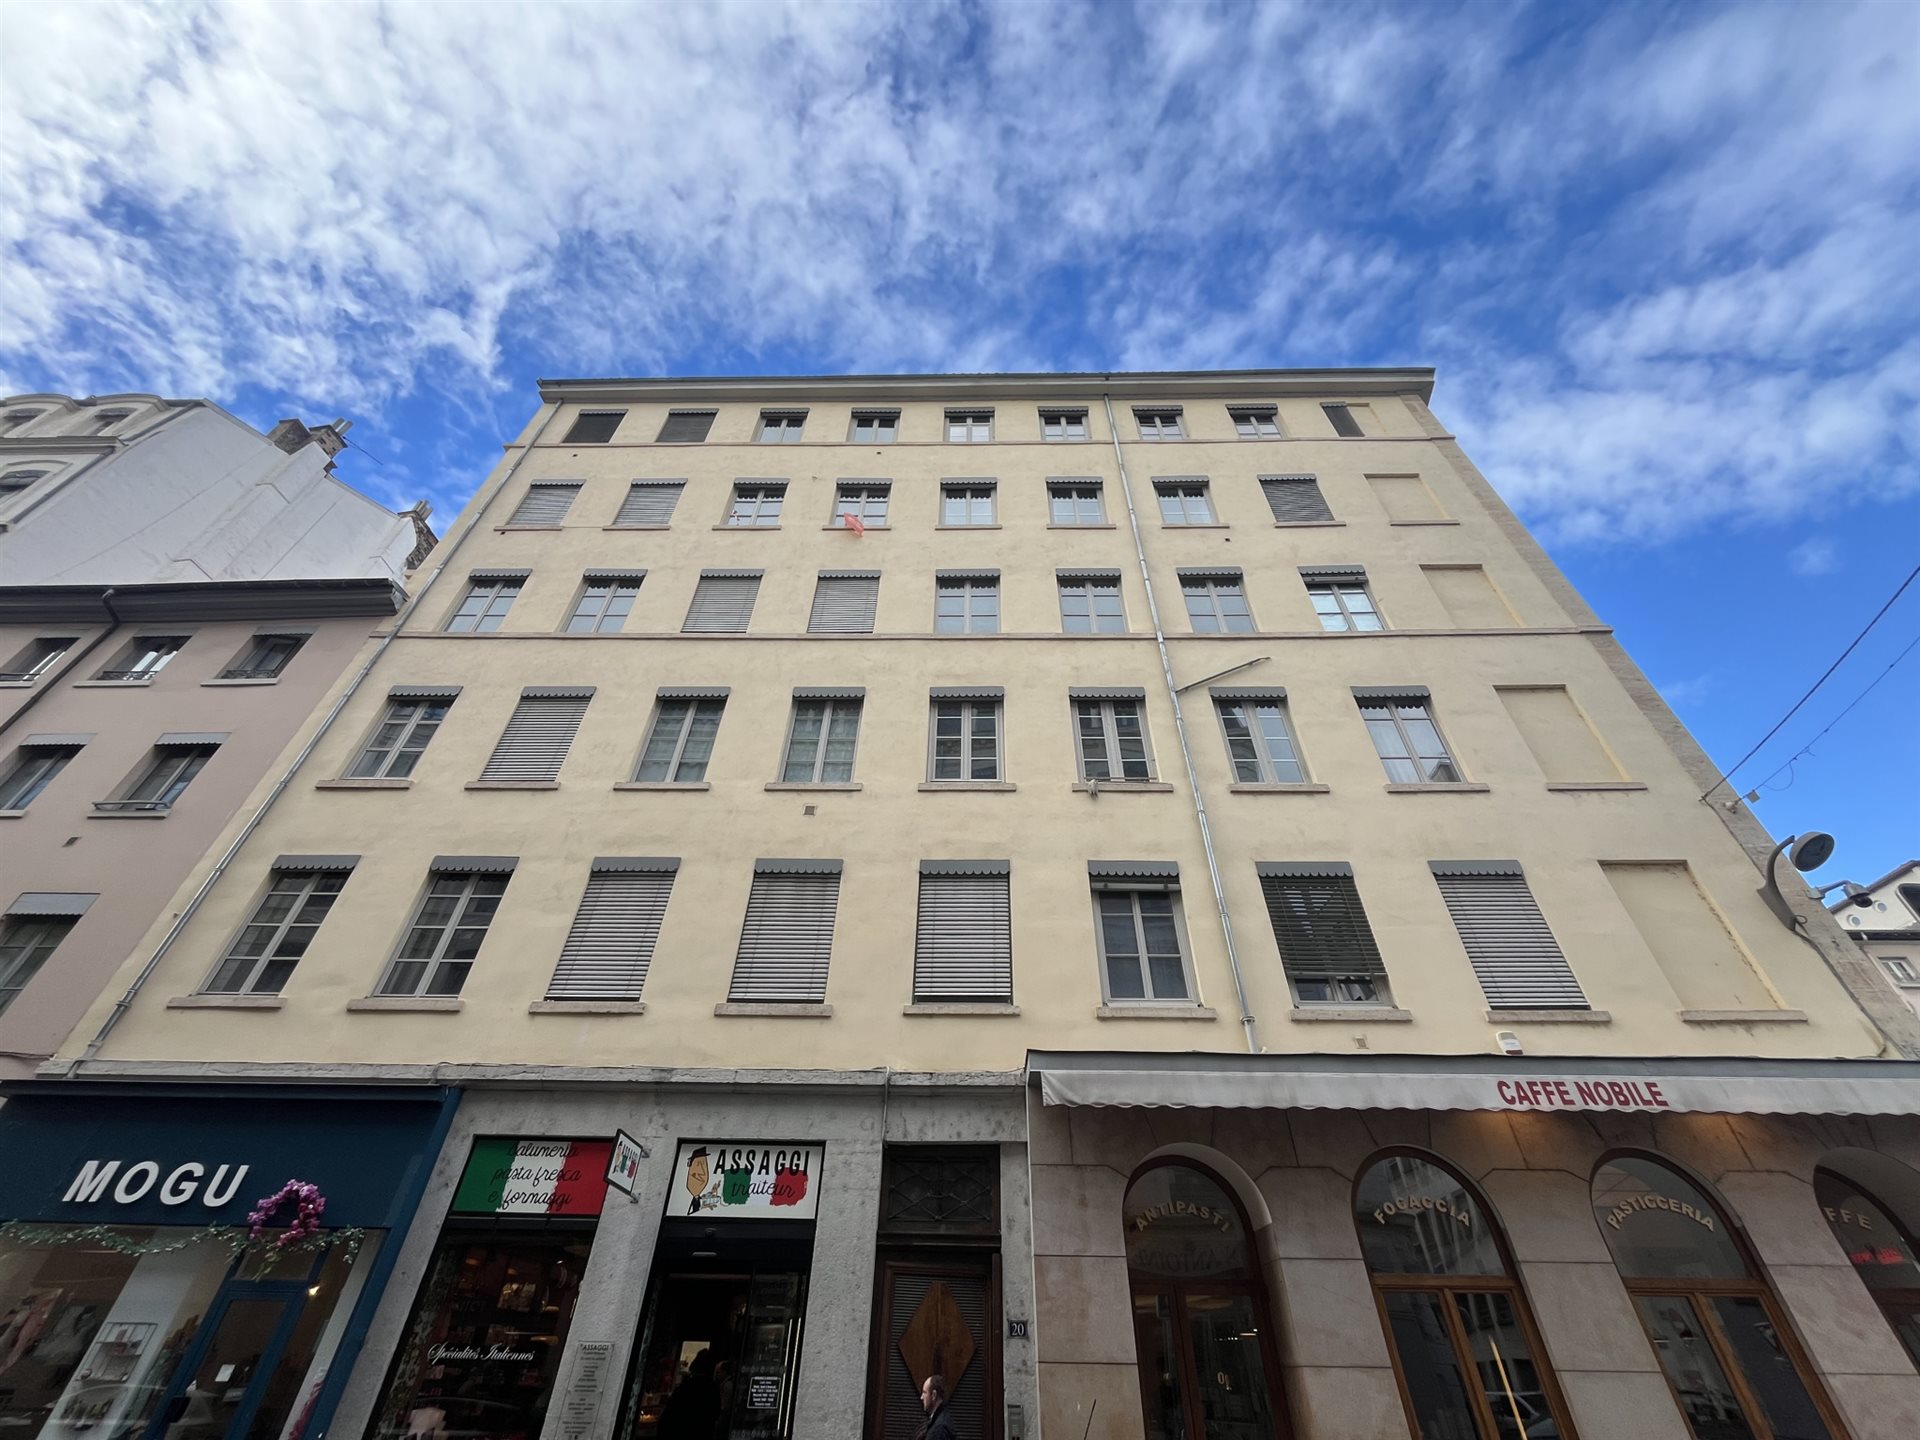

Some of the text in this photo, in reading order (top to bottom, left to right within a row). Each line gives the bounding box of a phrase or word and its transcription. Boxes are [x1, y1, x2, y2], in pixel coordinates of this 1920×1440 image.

[1497, 1080, 1669, 1107] CAFFE NOBILE
[713, 1149, 810, 1176] ASSAGGI
[62, 1160, 250, 1207] MOGU
[489, 1166, 582, 1187] pasta fresca
[488, 1188, 573, 1212] e formaggi
[731, 1180, 795, 1199] traiteur
[1135, 1201, 1230, 1232] ANTIPASTI
[1011, 1322, 1025, 1336] 20
[480, 1342, 535, 1361] Italiennes
